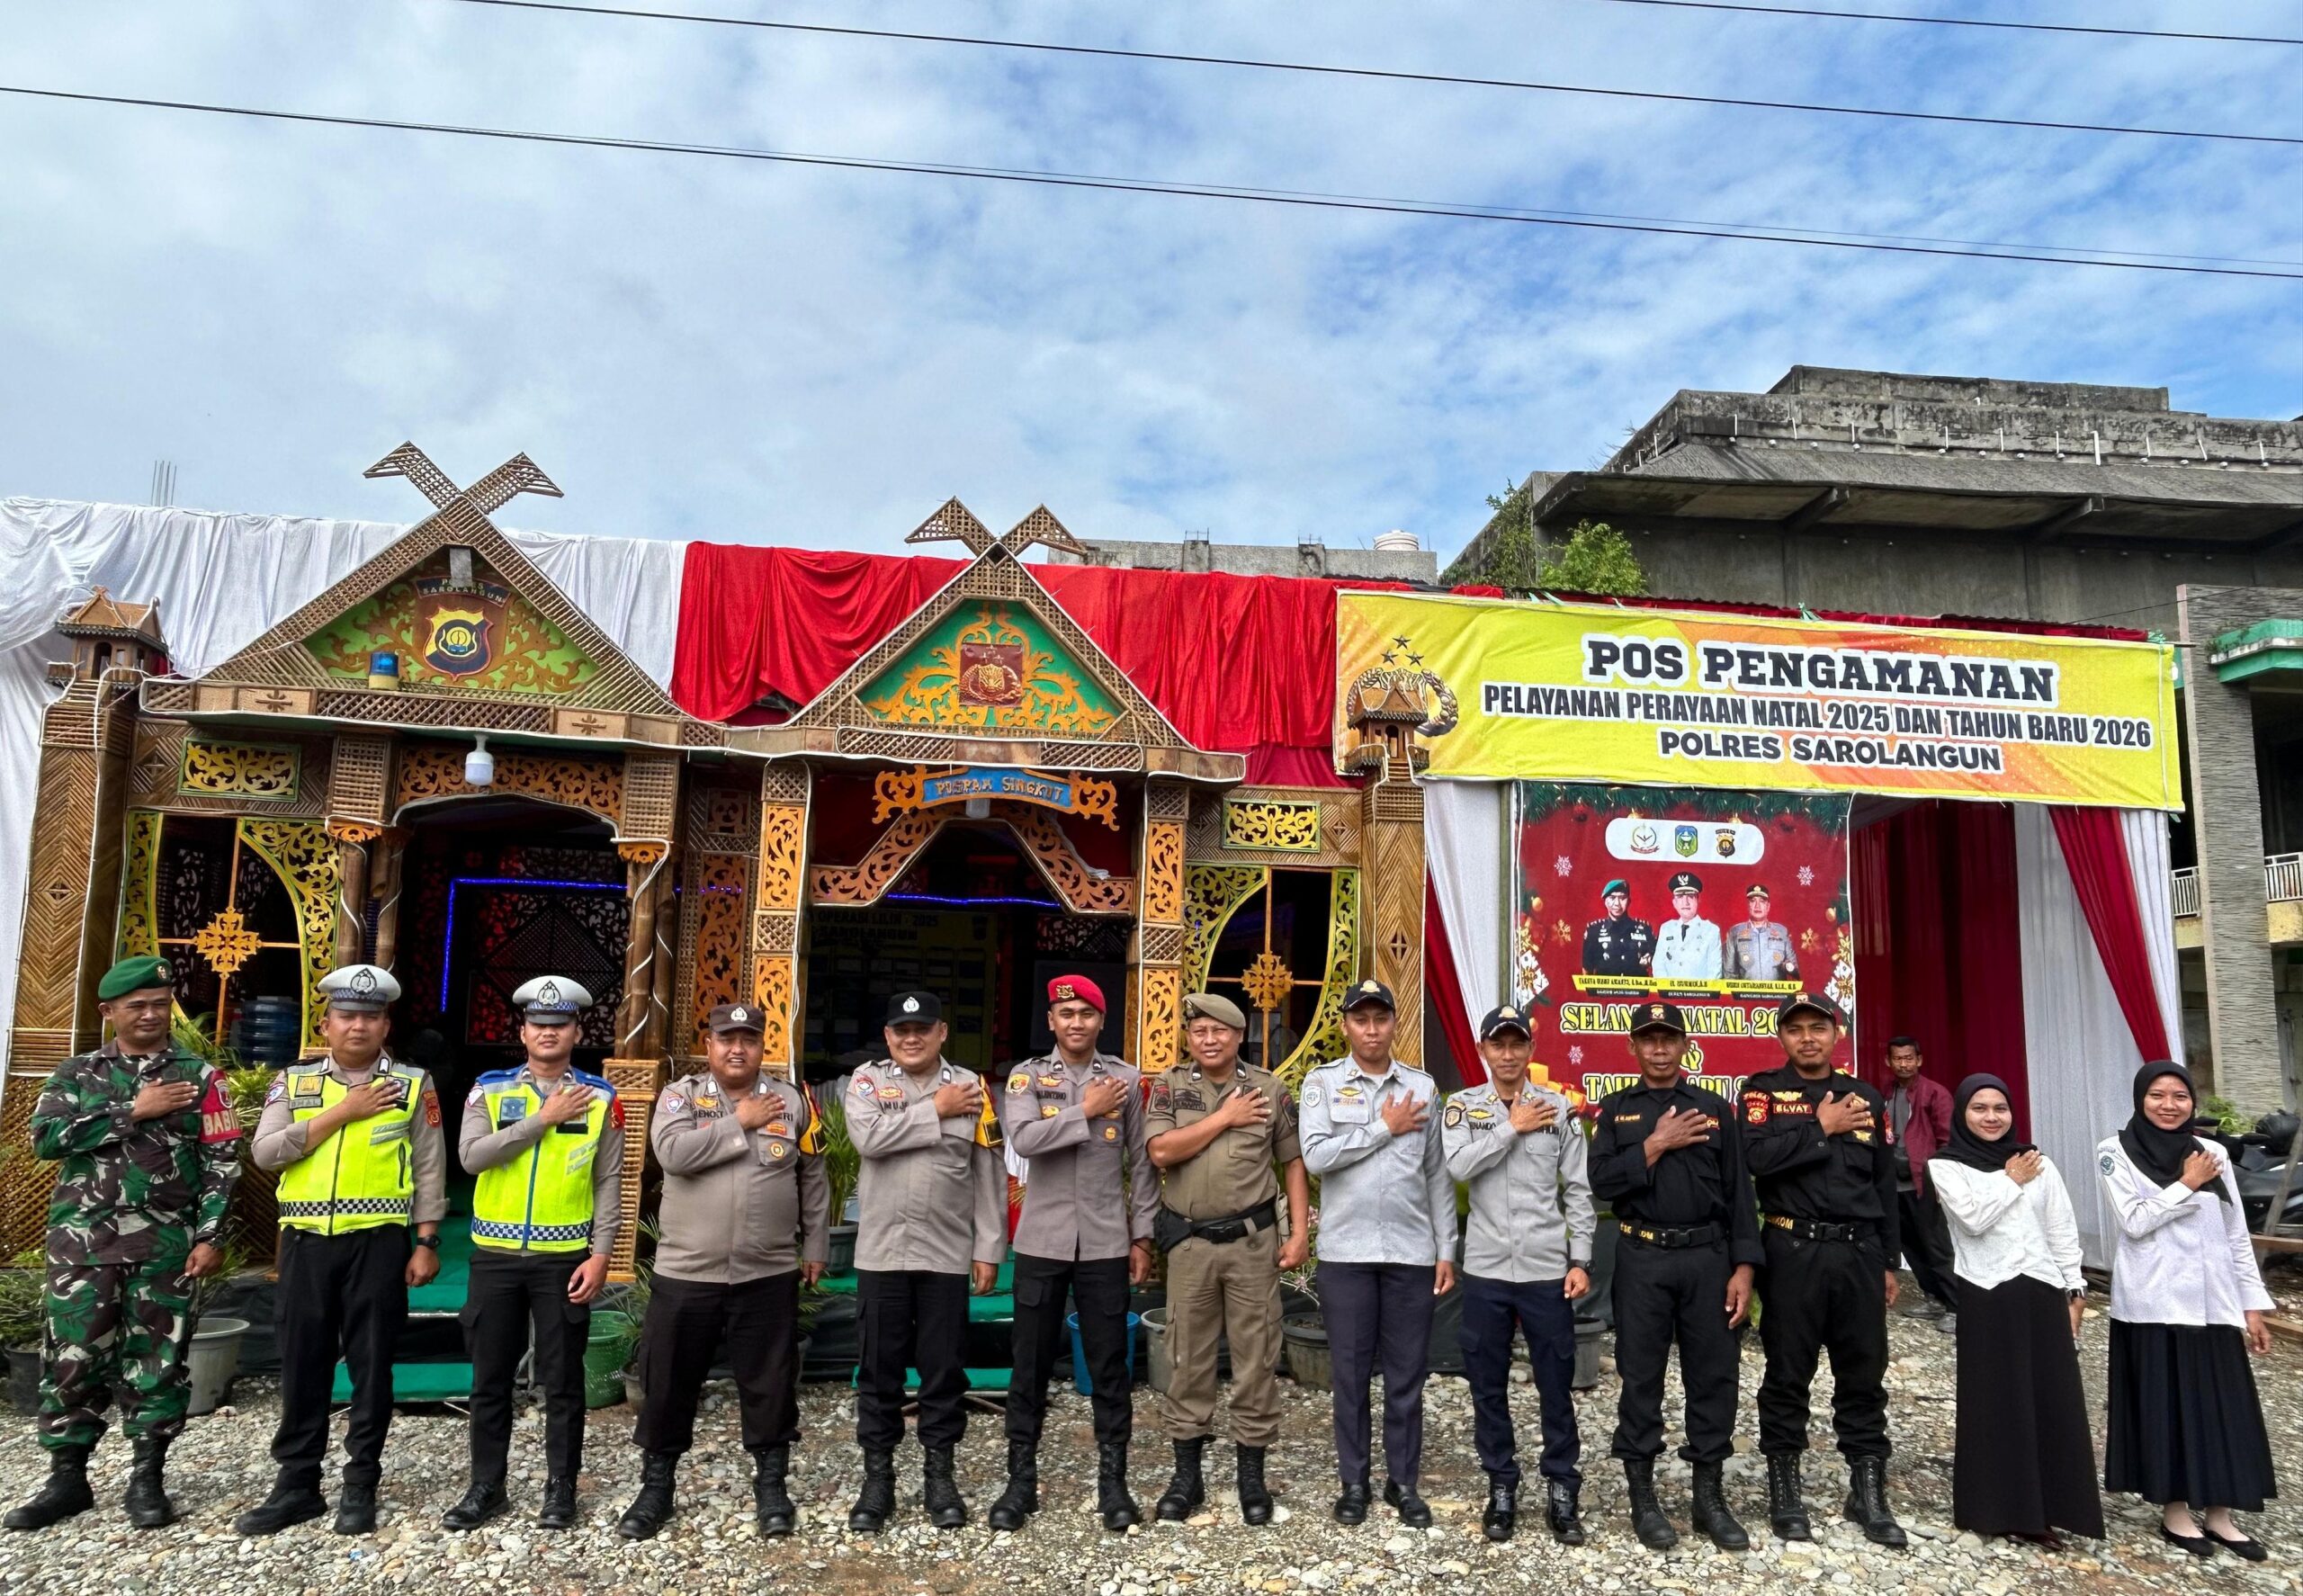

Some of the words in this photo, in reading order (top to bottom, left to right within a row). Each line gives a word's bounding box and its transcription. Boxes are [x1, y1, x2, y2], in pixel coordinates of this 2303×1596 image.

[422, 586, 503, 603] SAROLANGUN
[1588, 640, 1683, 680] POS
[1703, 646, 2054, 703] PENGAMANAN
[1484, 684, 1619, 719] PELAYANAN
[1626, 693, 1745, 726] PERAYAAN
[1752, 699, 1822, 730] NATAL
[1827, 702, 1890, 733] 2025
[1895, 707, 1942, 736] DAN
[1946, 710, 2023, 740] TAHUN
[2029, 713, 2087, 743] BARU
[2092, 719, 2151, 748] 2026
[1661, 731, 1780, 760] POLRES
[1793, 738, 2003, 772] SAROLANGUN
[1001, 776, 1063, 800] SINGKUT
[1679, 1007, 1750, 1035] NATAL
[1752, 1009, 1779, 1036] 20
